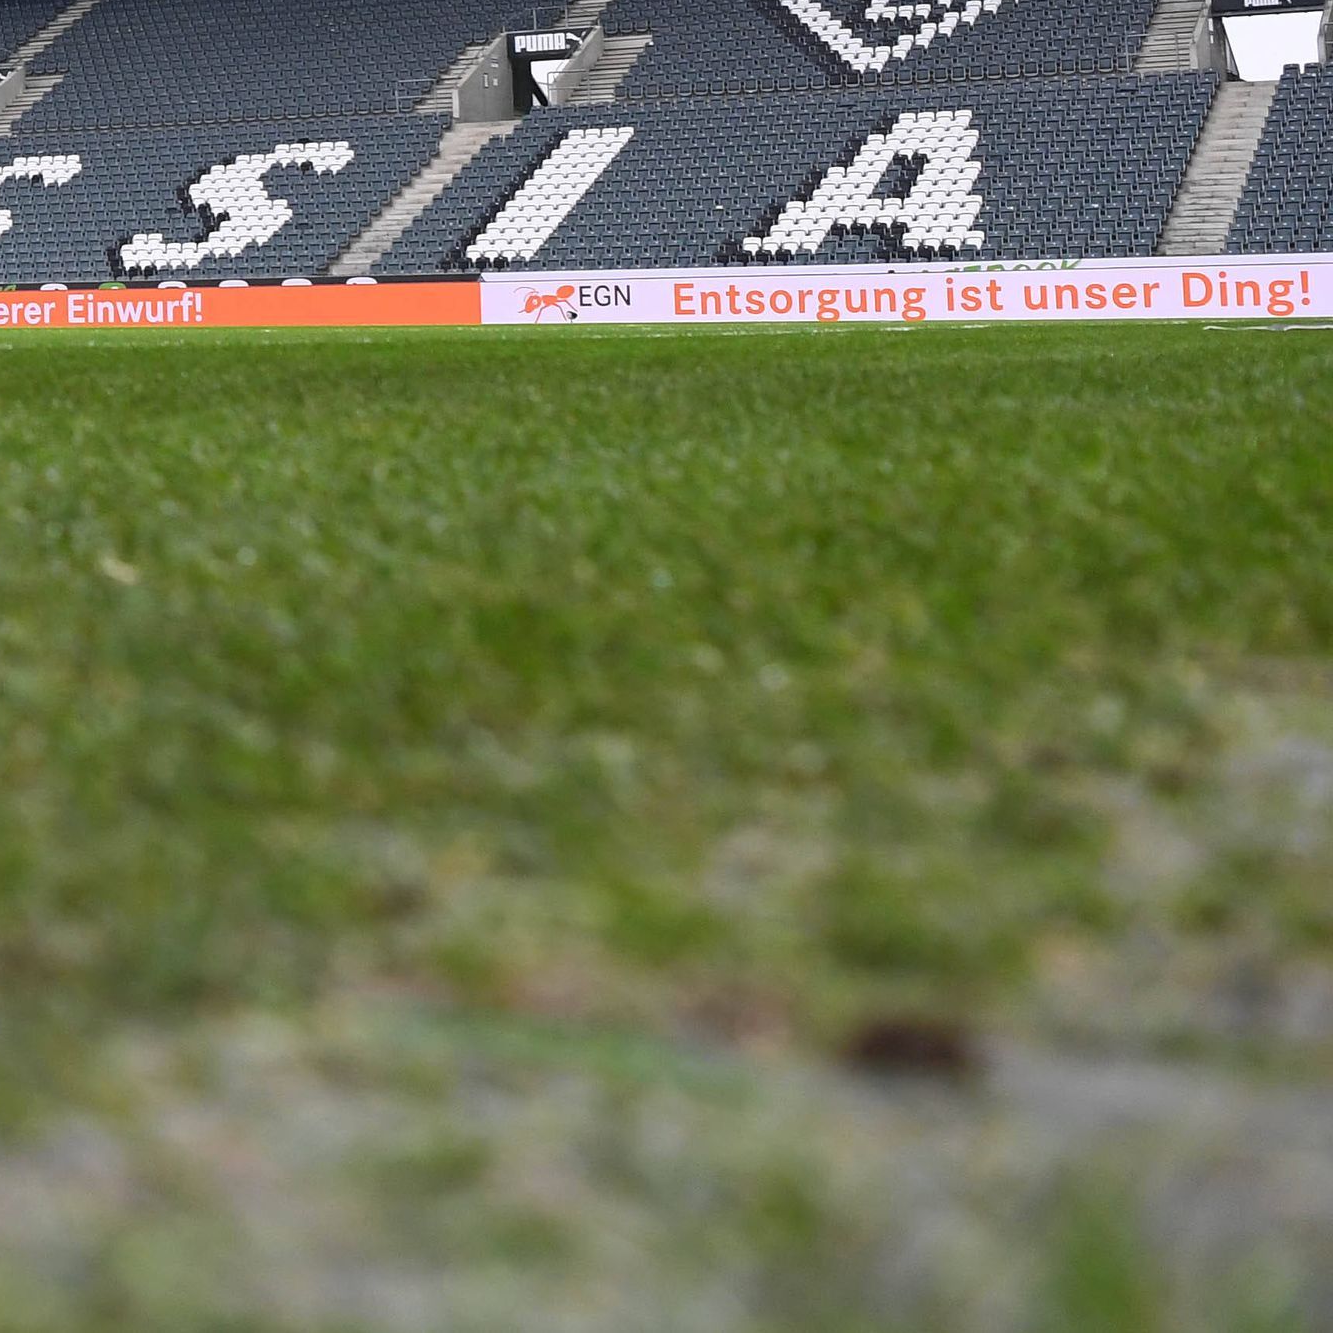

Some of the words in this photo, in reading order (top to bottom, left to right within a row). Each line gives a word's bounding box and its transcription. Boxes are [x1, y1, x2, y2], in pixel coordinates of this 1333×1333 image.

[514, 33, 566, 53] PUMA
[67, 291, 203, 324] Einwurf!
[579, 285, 631, 307] EGN
[674, 282, 926, 322] Entsorgung
[946, 277, 1004, 312] ist
[1023, 281, 1161, 311] unser
[1181, 271, 1311, 316] Ding!
